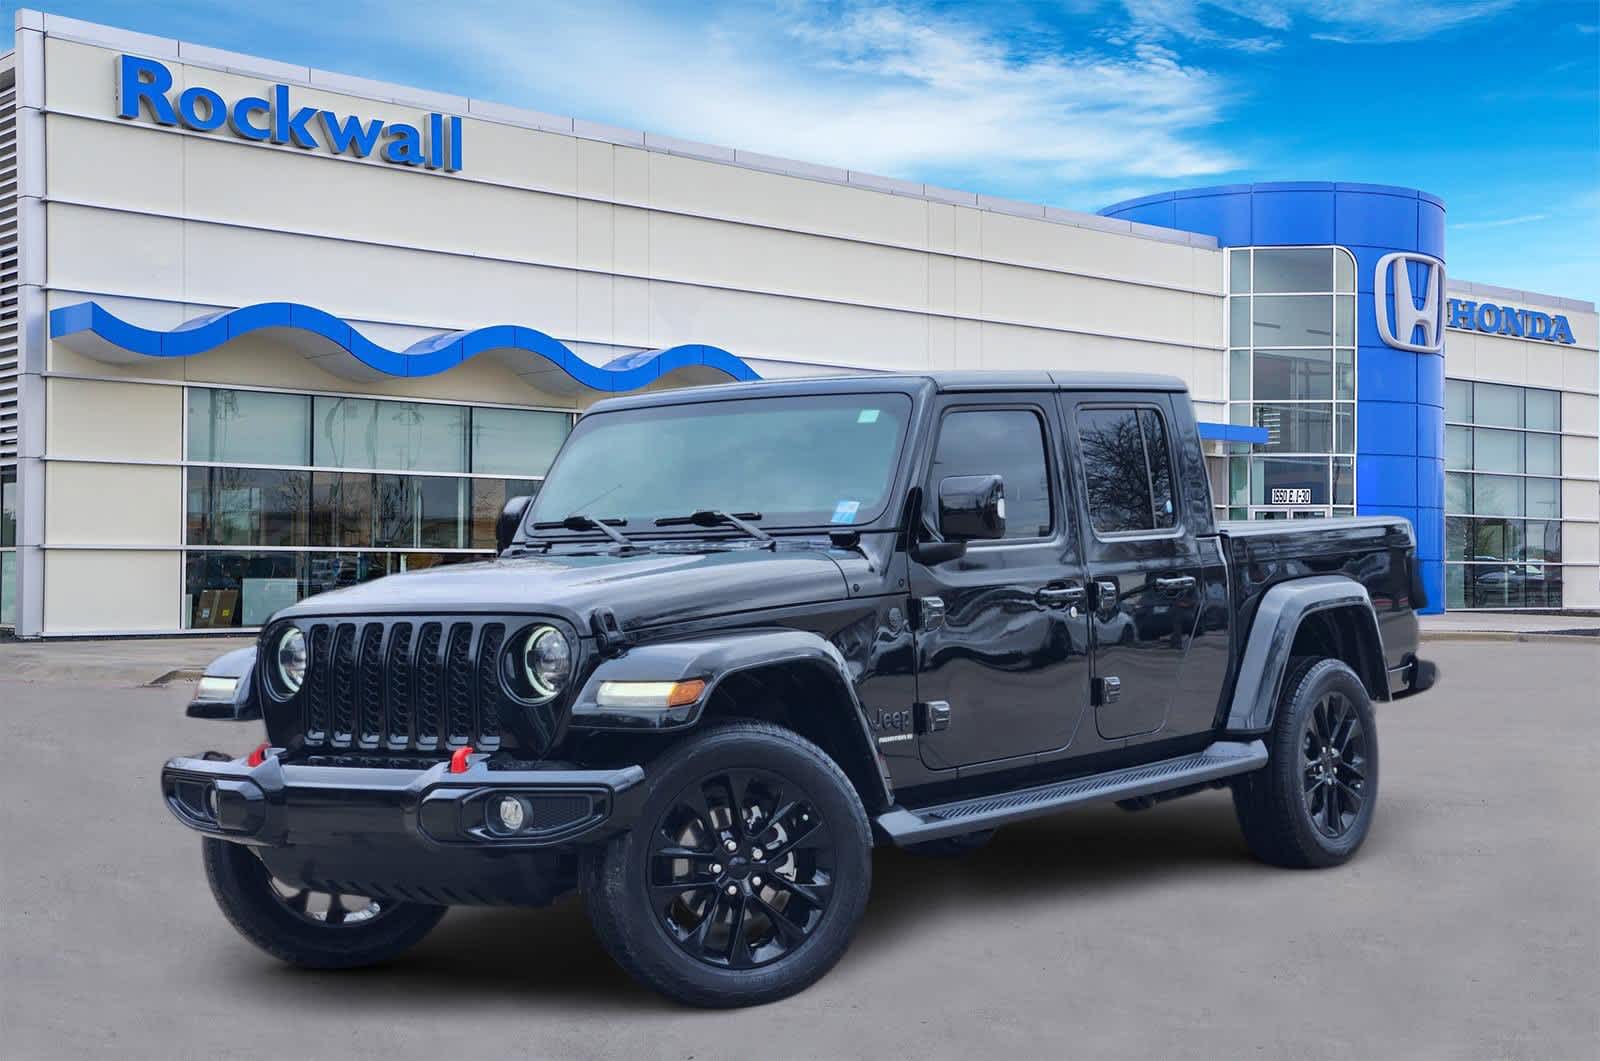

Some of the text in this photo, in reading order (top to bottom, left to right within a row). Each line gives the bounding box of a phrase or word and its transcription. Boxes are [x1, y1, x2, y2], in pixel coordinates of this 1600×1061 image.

[117, 54, 463, 172] Rockwall
[1447, 298, 1577, 344] HONDA
[872, 707, 910, 732] Jeep
